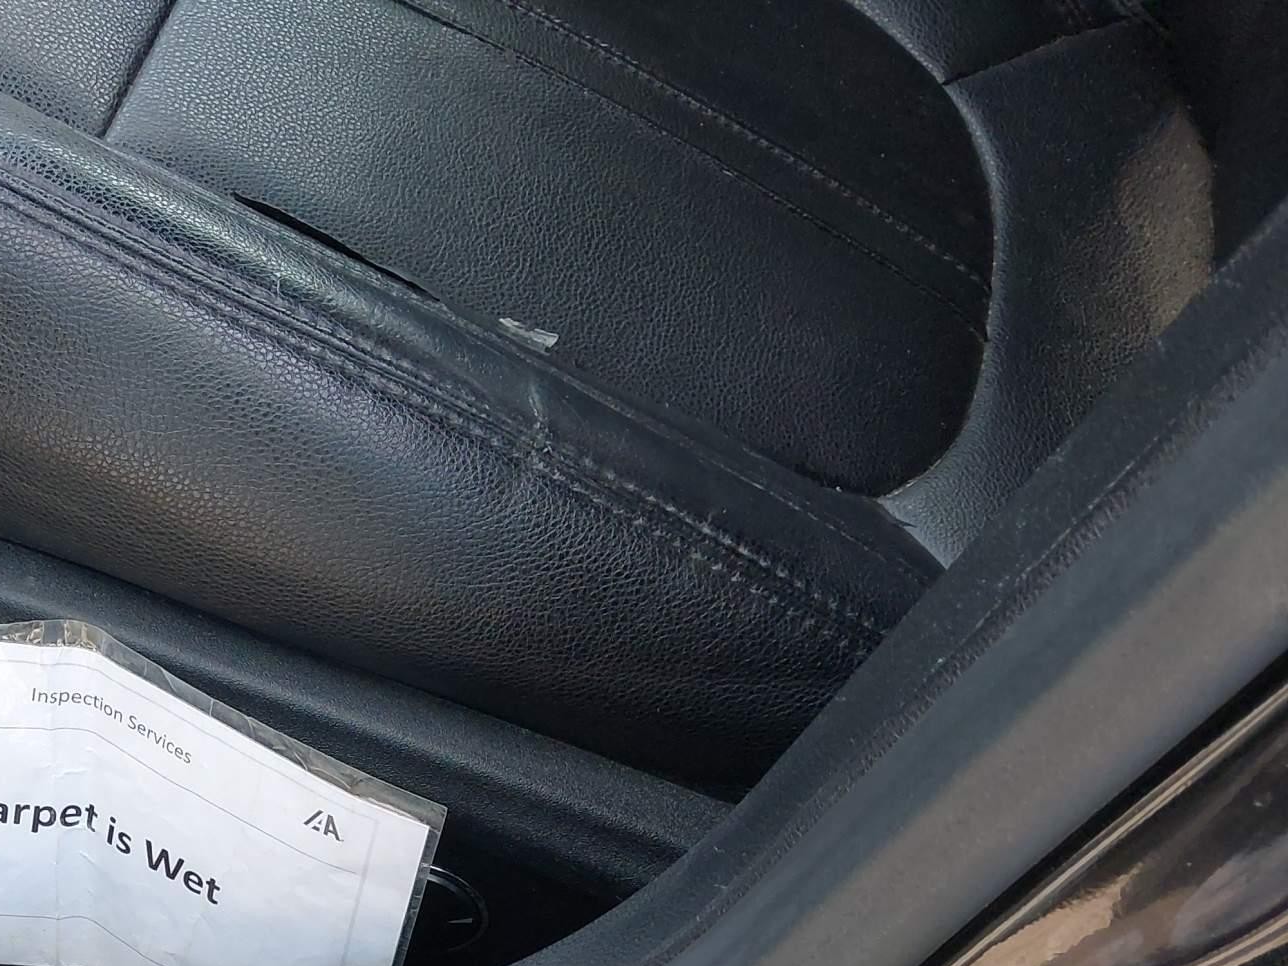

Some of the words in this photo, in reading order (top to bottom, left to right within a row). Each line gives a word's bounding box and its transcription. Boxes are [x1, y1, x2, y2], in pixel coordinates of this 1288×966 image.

[31, 687, 123, 724] Inspection
[127, 715, 192, 765] Services
[106, 817, 132, 855] is
[145, 839, 221, 905] Wet
